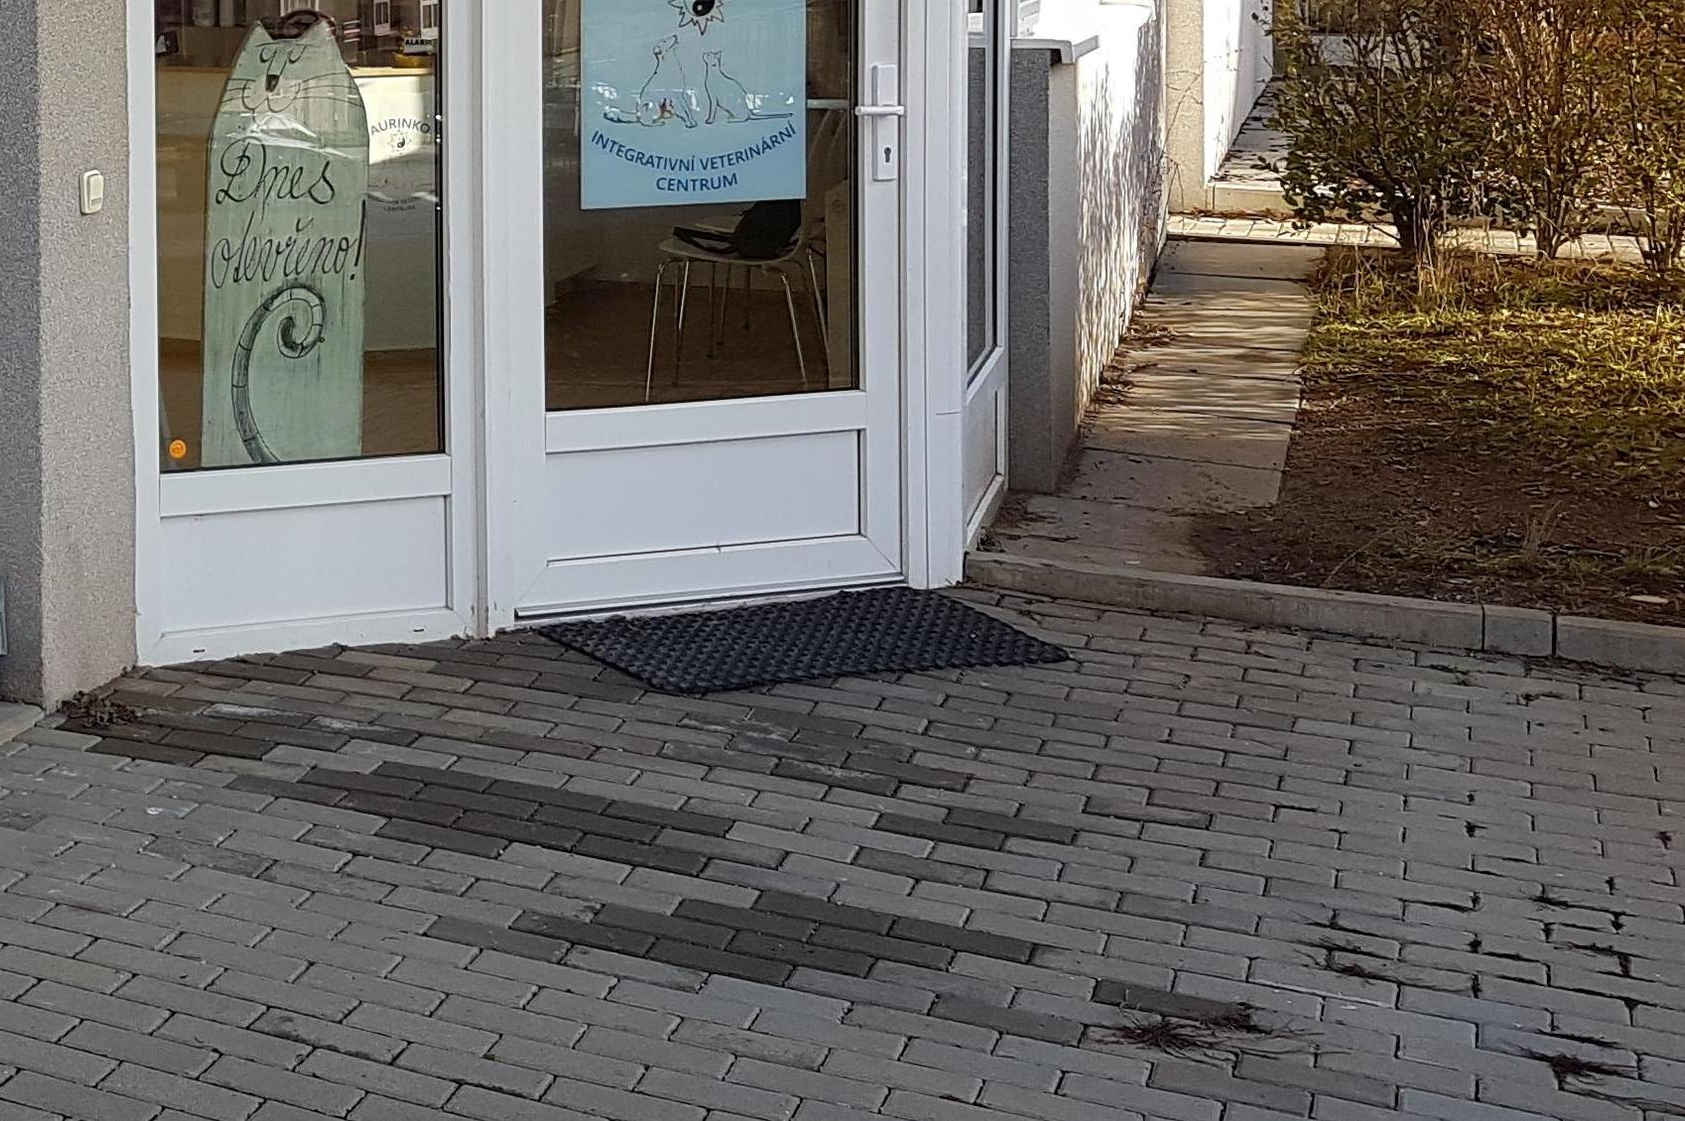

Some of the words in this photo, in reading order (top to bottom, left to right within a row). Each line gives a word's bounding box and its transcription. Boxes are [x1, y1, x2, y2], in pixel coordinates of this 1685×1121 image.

[371, 118, 431, 136] AURINKO
[591, 130, 695, 171] INTEGRATIVNÍ
[699, 120, 797, 170] VETERINÁRNÍ
[216, 136, 335, 205] Dnes
[656, 173, 738, 192] CENTRUM
